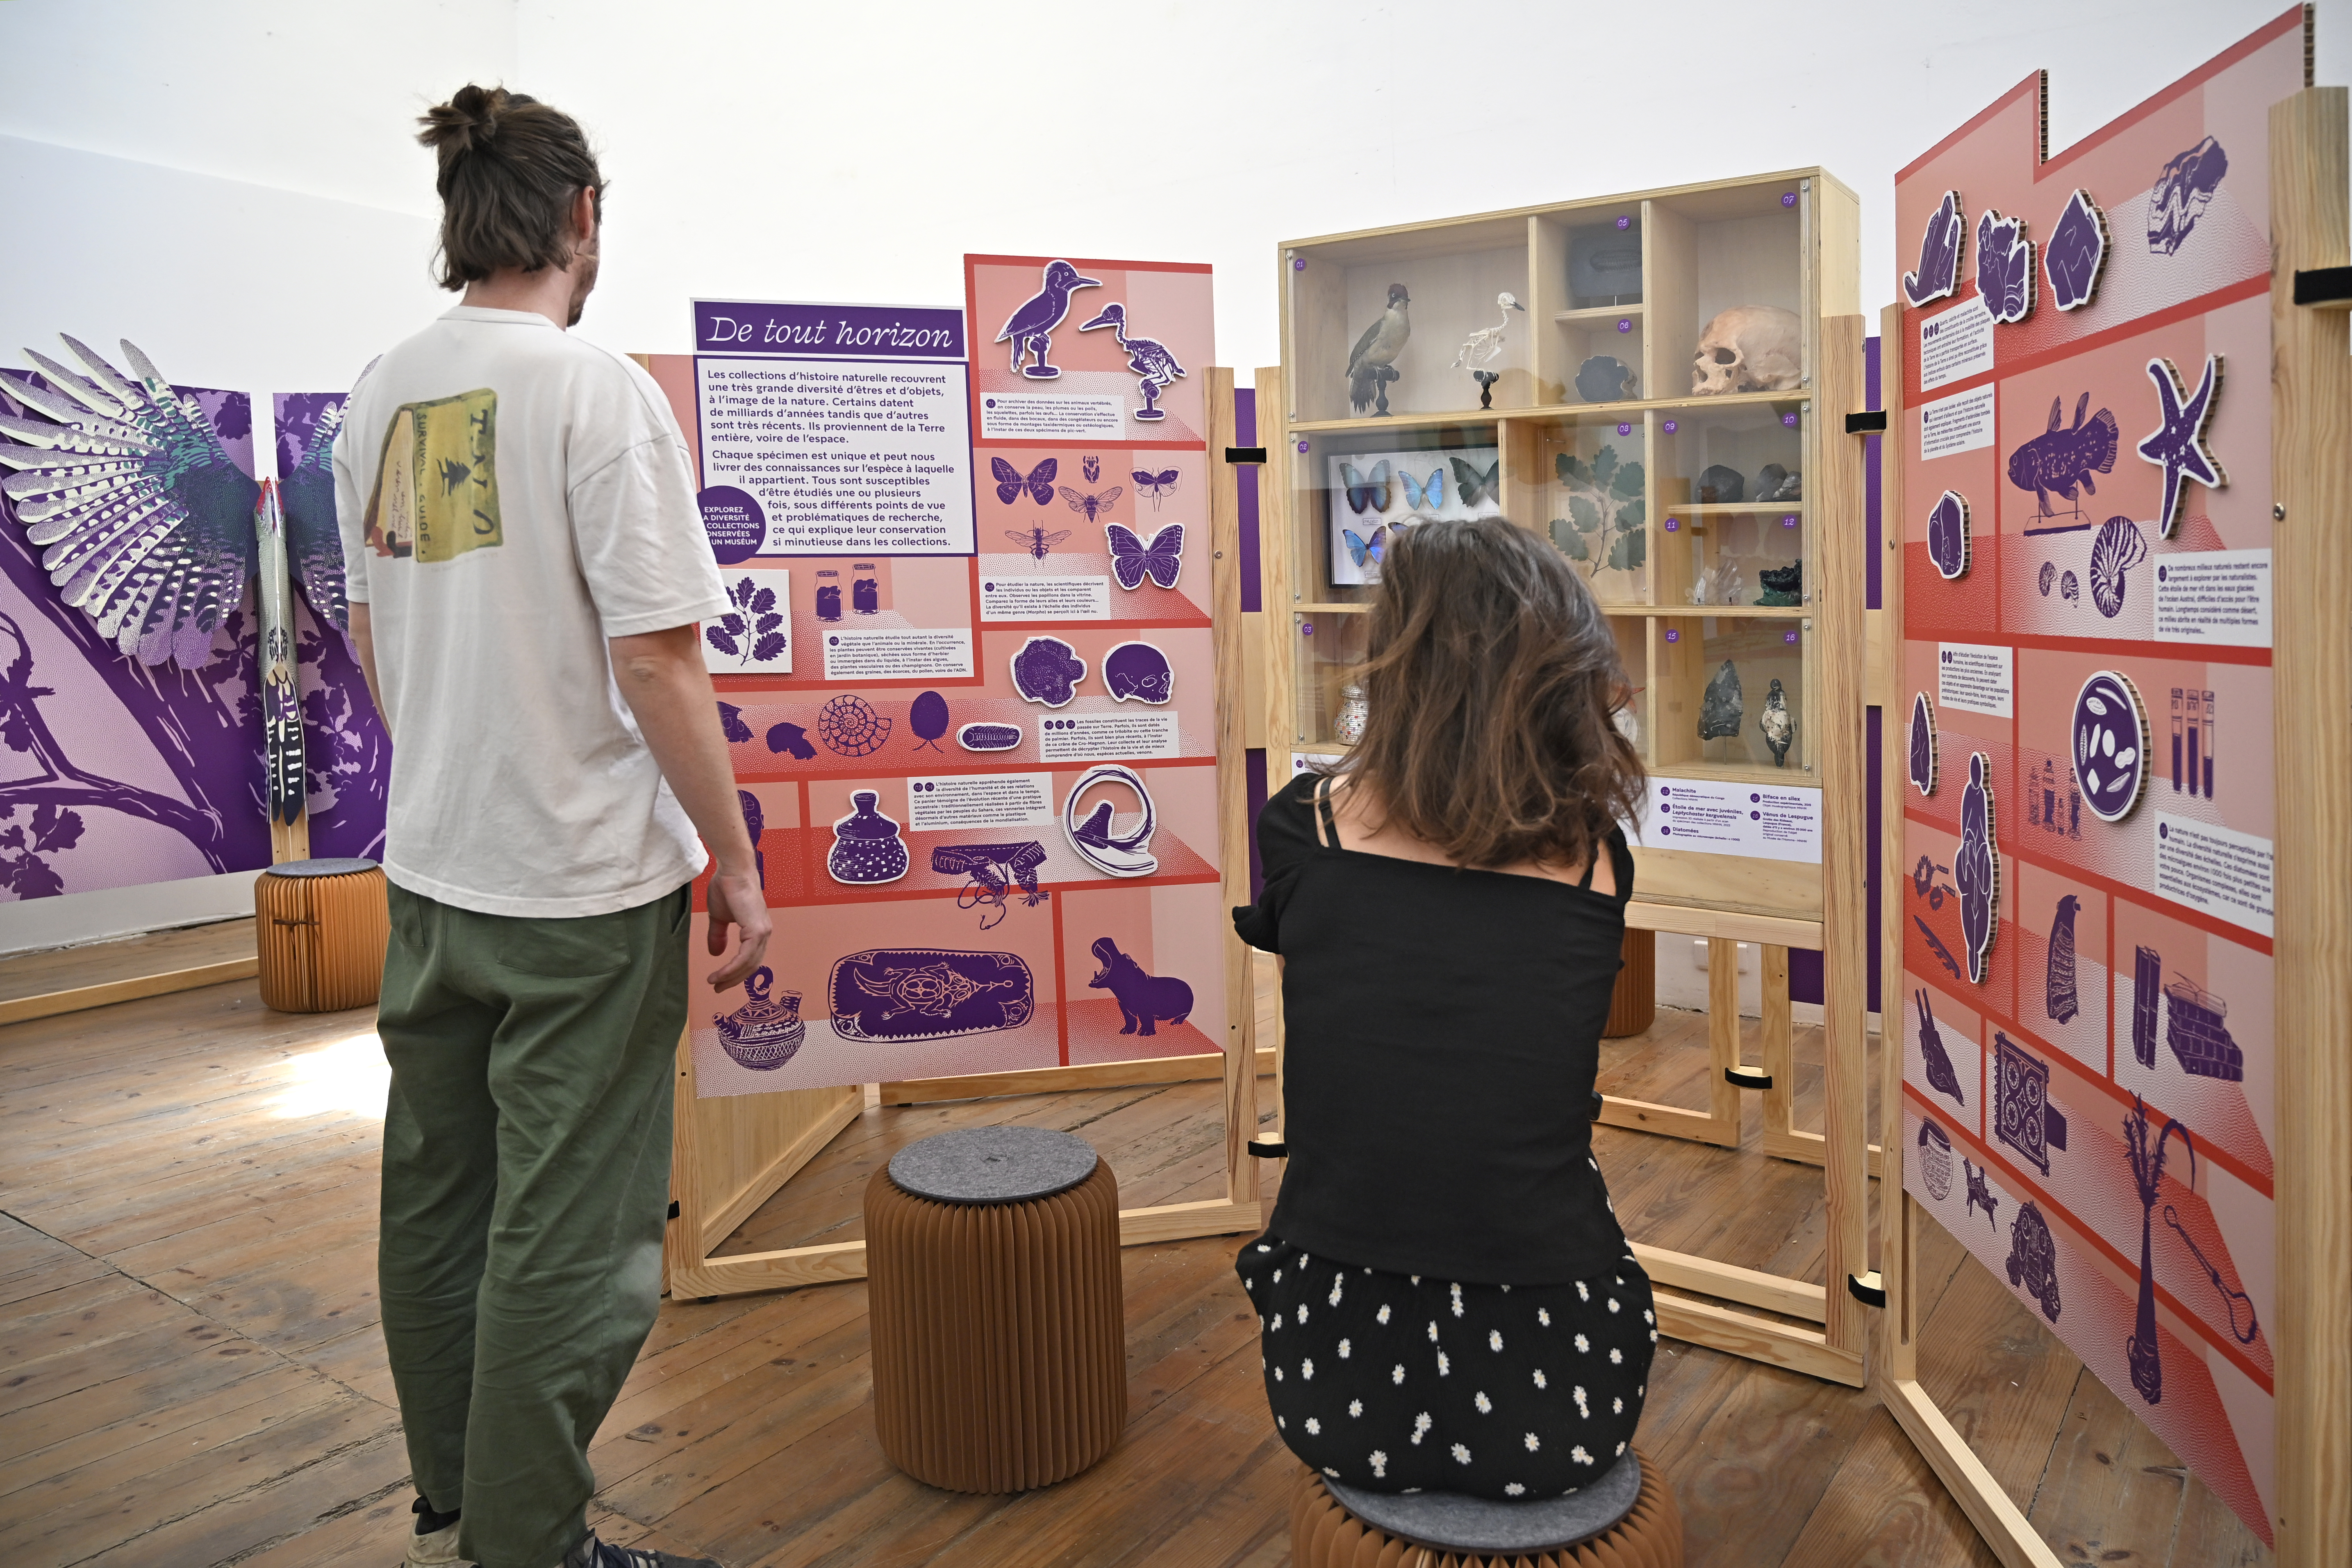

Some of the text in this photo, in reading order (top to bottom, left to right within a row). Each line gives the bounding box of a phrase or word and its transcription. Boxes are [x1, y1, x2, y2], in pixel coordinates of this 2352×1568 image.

[1783, 195, 1794, 204] 07
[1618, 218, 1627, 226] 05
[706, 317, 952, 347] De tout horizon
[708, 370, 725, 378] Les
[729, 371, 786, 380] collections
[789, 372, 839, 381] d'histoire
[842, 373, 887, 382] naturelle
[731, 383, 753, 391] très
[756, 384, 794, 394] grande
[797, 384, 843, 393] diversité
[847, 385, 882, 394] d'êtres
[900, 386, 944, 397] d'objets,
[709, 395, 914, 407] à l'image de la nature. Certains datent
[710, 407, 723, 416] de
[727, 408, 773, 417] milliards
[777, 409, 824, 418] d'années
[828, 410, 860, 418] tandis
[886, 411, 928, 419] d'autres
[737, 421, 758, 429] très
[762, 421, 805, 430] récents.
[809, 422, 820, 430] Ils
[824, 422, 887, 432] proviennent
[891, 423, 903, 431] de
[907, 423, 915, 431] la
[918, 423, 945, 432] Terre
[712, 433, 848, 444] entière, voire de l'espace.
[712, 450, 753, 460] Chaque
[757, 451, 808, 461] spécimen
[831, 451, 866, 462] unique
[884, 453, 907, 462] peut
[713, 462, 741, 471] livrer
[744, 463, 762, 471] des
[766, 463, 840, 472] connaissances
[862, 464, 903, 474] l'espèce
[906, 464, 911, 473] à
[915, 464, 954, 474] laquelle
[739, 475, 745, 483] il
[749, 476, 808, 485] appartient.
[812, 476, 836, 484] Tous
[866, 476, 930, 487] susceptibles
[759, 488, 790, 496] d'être
[794, 488, 833, 496] étudiés
[875, 489, 921, 498] plusieurs
[767, 500, 790, 510] fois,
[821, 501, 872, 509] différents
[876, 501, 908, 511] points
[911, 501, 924, 509] de
[786, 513, 869, 523] problématiques
[872, 513, 885, 521] de
[889, 513, 942, 522] recherche,
[788, 525, 804, 535] qui
[808, 525, 853, 535] explique
[857, 525, 876, 533] leur
[880, 525, 946, 533] conservation
[773, 537, 950, 546] si minutieuse dans les collections.
